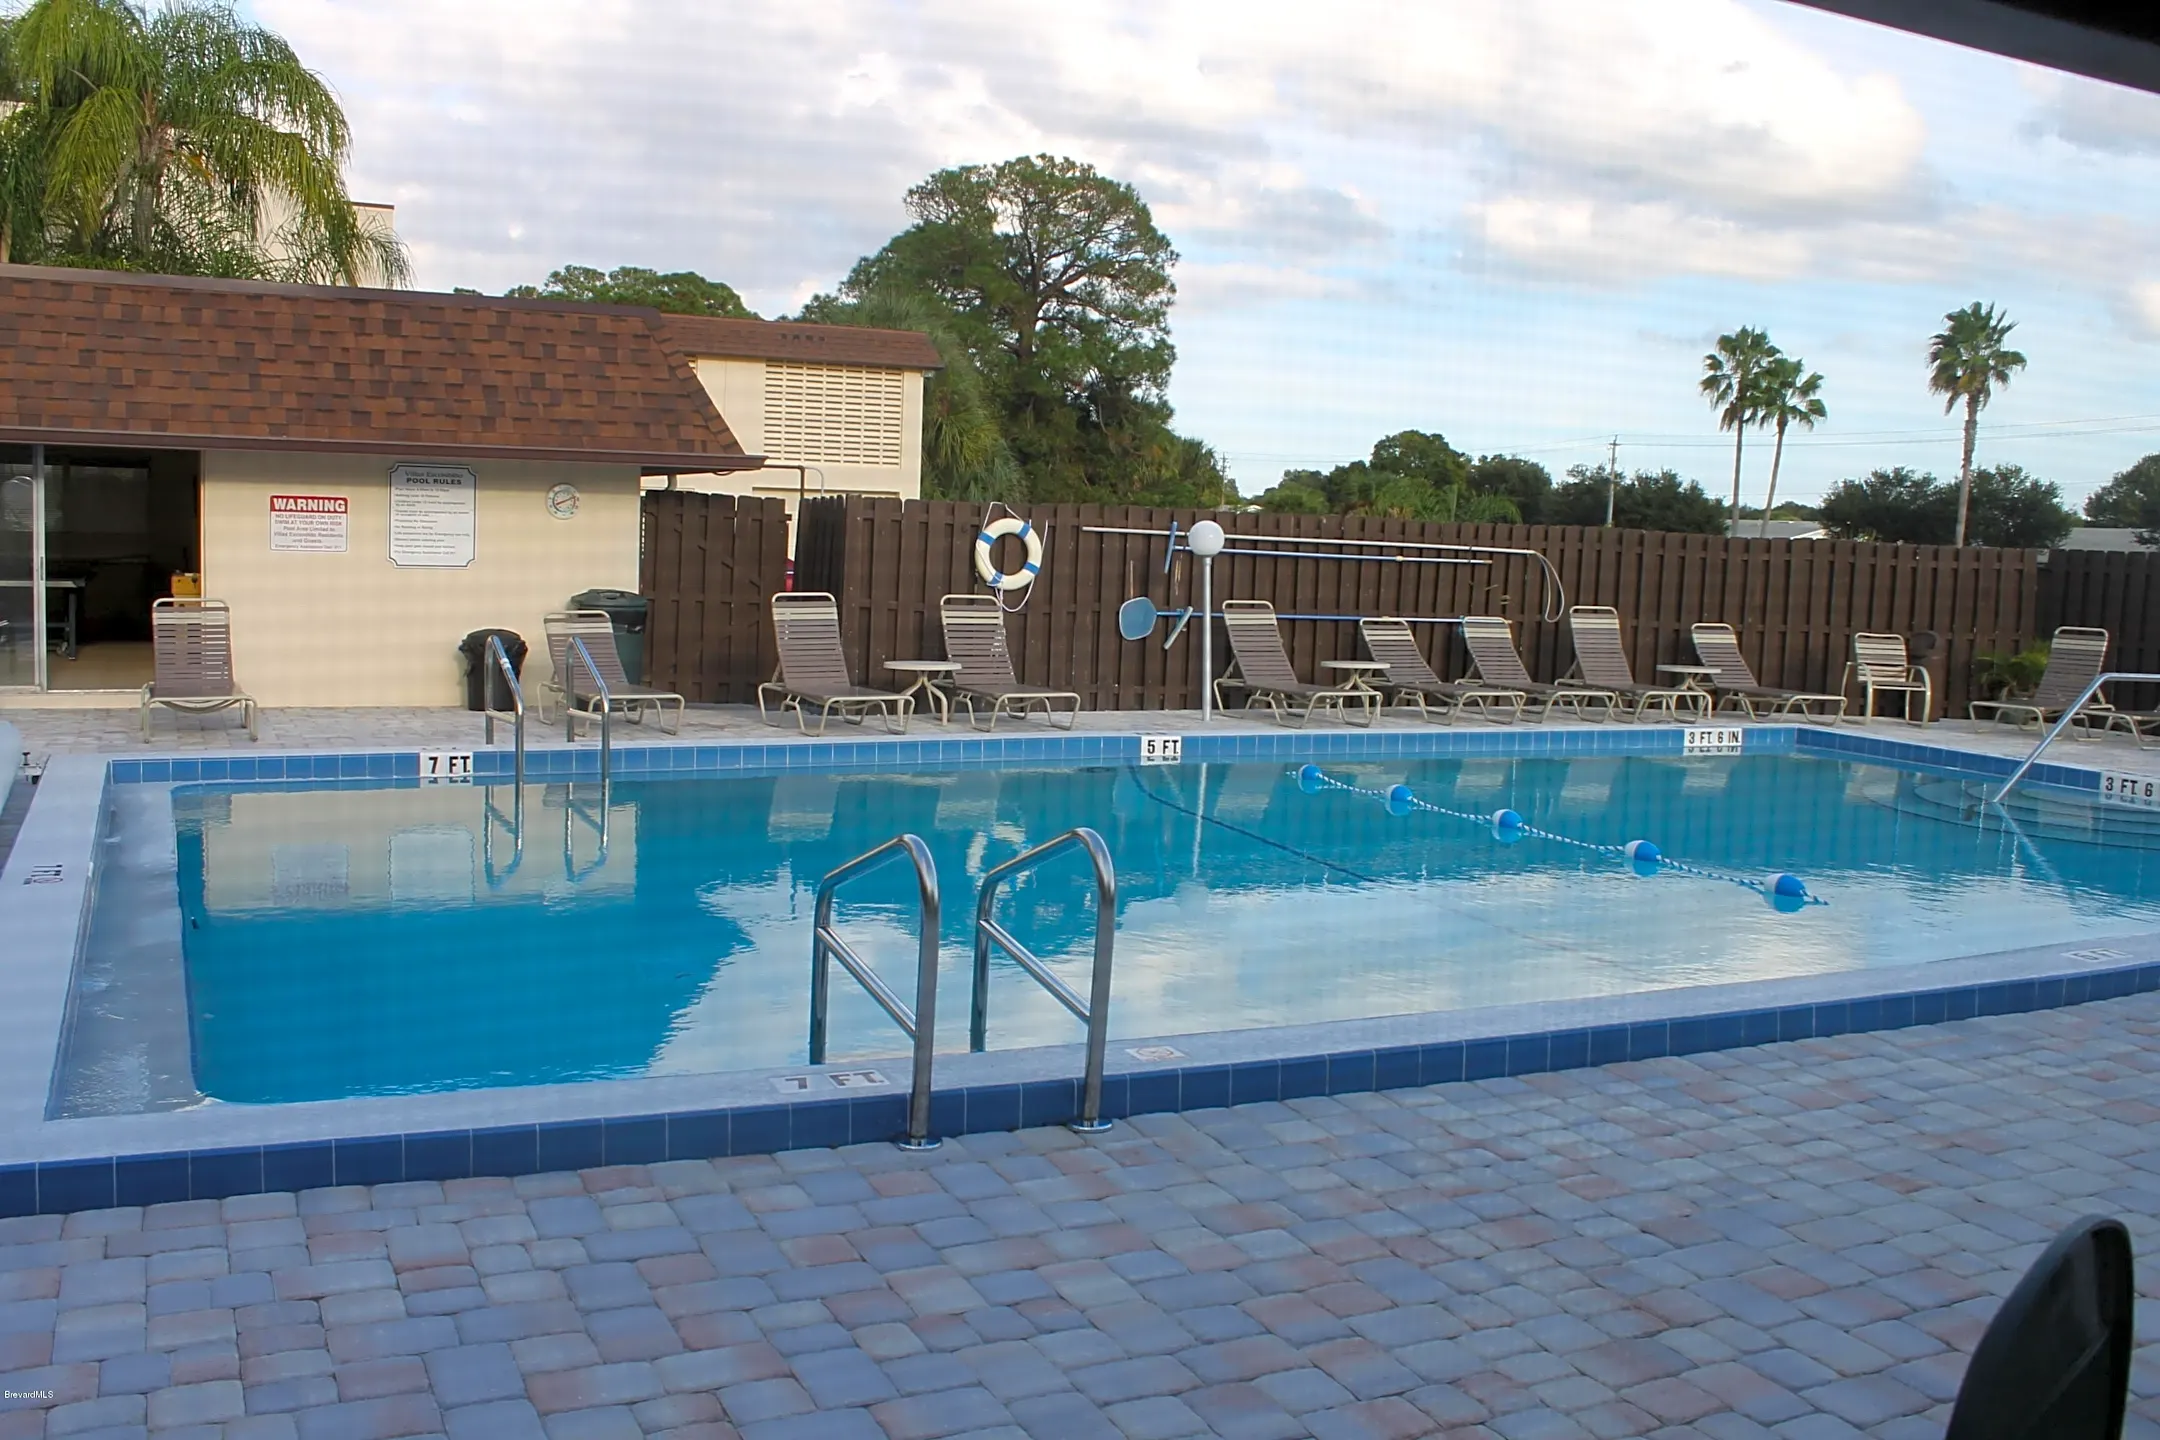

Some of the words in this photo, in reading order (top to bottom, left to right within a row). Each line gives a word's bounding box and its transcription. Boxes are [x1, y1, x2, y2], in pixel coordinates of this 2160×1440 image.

[273, 498, 346, 512] WARNING
[1689, 731, 1695, 744] 3
[1717, 731, 1724, 743] 6
[1147, 740, 1156, 754] 5
[1162, 740, 1180, 754] FT.
[428, 756, 438, 774] 7
[449, 756, 471, 774] FT.
[2105, 776, 2114, 791] 3
[2144, 782, 2154, 797] 6
[785, 1077, 808, 1089] 7
